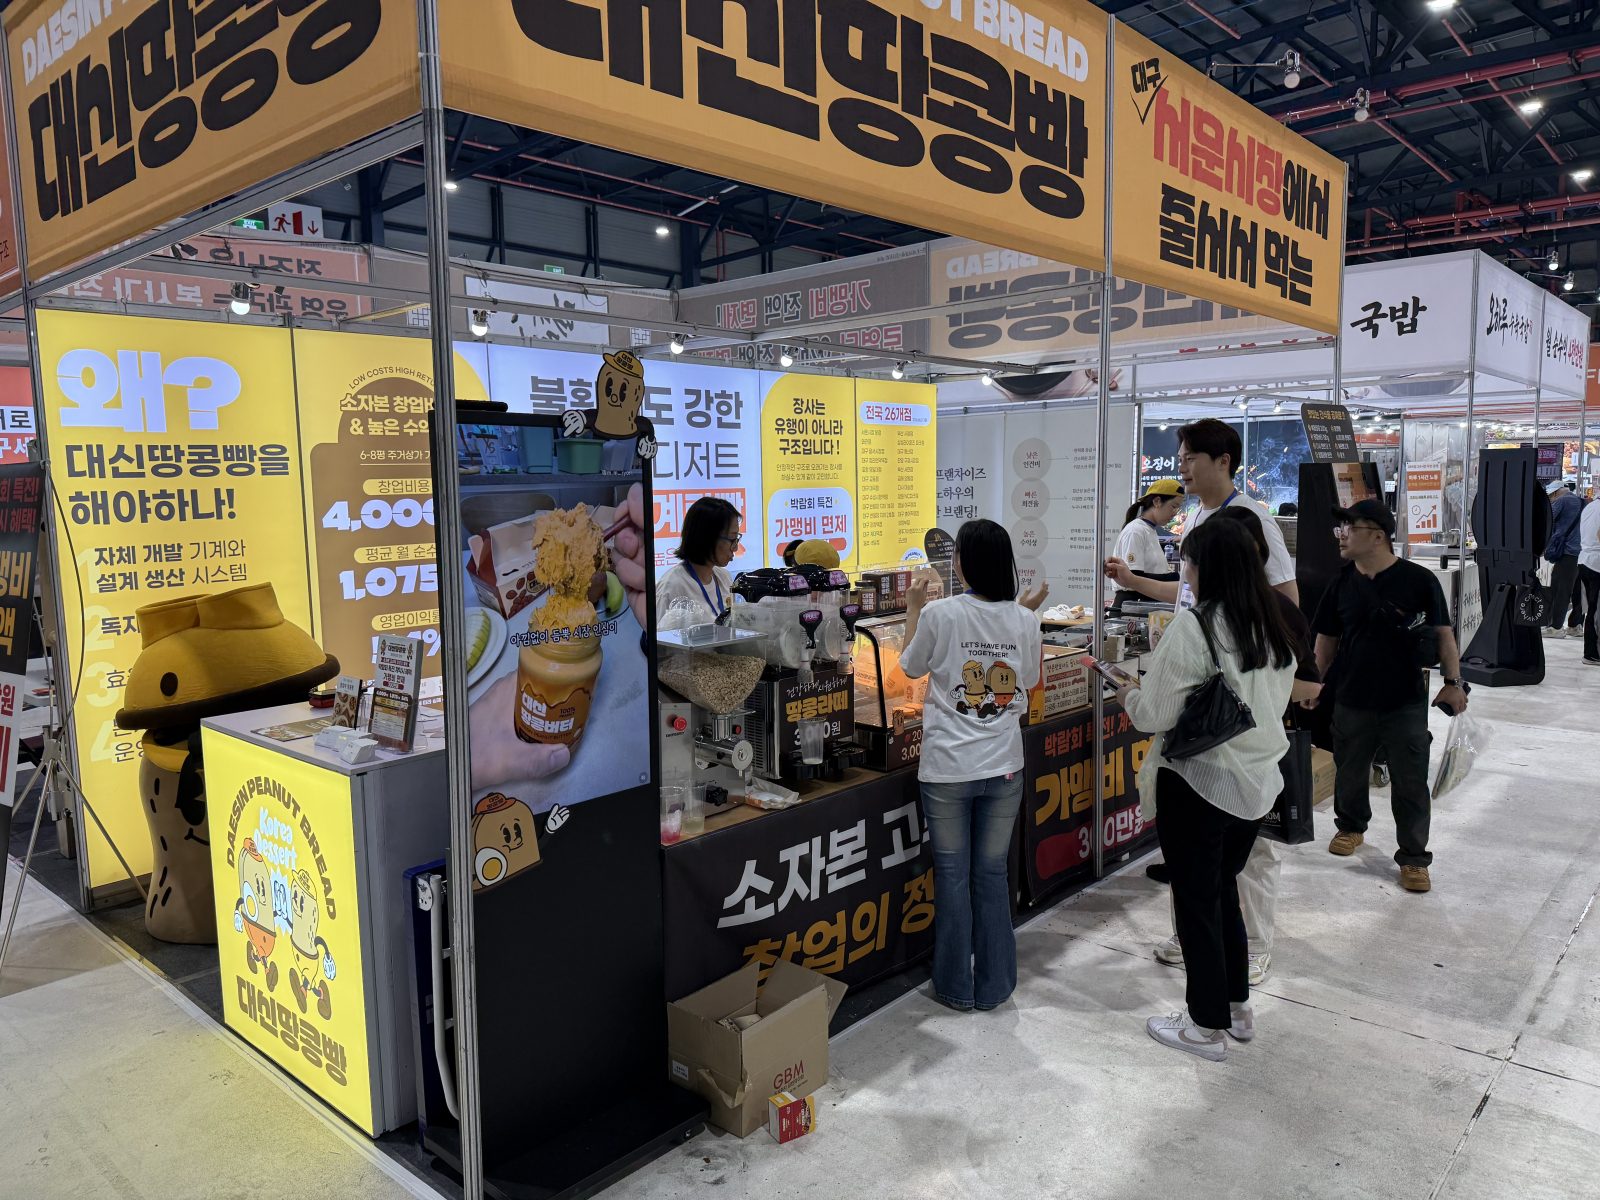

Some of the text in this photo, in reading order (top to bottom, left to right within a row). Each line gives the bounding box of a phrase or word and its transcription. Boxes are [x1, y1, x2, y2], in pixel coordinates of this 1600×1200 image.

[22, 0, 102, 86] DAESIN
[974, 0, 1088, 82] BREAD
[1130, 57, 1162, 94] 대구
[1153, 86, 1330, 240] 서문시장에서
[1159, 183, 1312, 307] 줄서서 먹는
[1350, 296, 1427, 339] 국밥
[57, 348, 241, 432] 왜?
[349, 373, 367, 390] LOW
[366, 366, 394, 378] COSTS
[395, 366, 416, 377] HIGH
[340, 393, 390, 413] 소자본
[684, 388, 744, 430] 강한
[793, 398, 826, 416] 장사는
[866, 405, 912, 421] 전국 26개점
[350, 418, 364, 436] &
[367, 417, 400, 436] 높은
[774, 417, 843, 436] 유행이 아니라
[65, 444, 290, 479] 대신땅콩빵을
[359, 450, 386, 460] 6-8평
[1144, 456, 1175, 471] 오징어
[13, 476, 40, 503] 특전!
[378, 479, 430, 494] 창업비용
[68, 487, 236, 525] 해야하나!
[791, 496, 833, 510] 박람회 특전
[943, 505, 978, 519] 브랜딩!
[10, 507, 37, 534] 혜택!
[775, 514, 847, 538] 가맹비 면제
[95, 539, 246, 567] 자체 개발 기계와
[365, 546, 392, 562] 평균
[396, 545, 410, 560] 월
[96, 564, 247, 593] 설계 생산 시스템
[510, 630, 549, 647] 아낌없이
[573, 623, 591, 638] 시장
[592, 621, 618, 635] 인심이
[961, 641, 1016, 651] LET'S HAVE FUN
[786, 690, 849, 723] 땅콩라떼
[1044, 724, 1083, 757] 박람회
[259, 806, 293, 845] Korea
[227, 775, 337, 921] DAESIN PEANUT BREAD
[253, 828, 297, 871] Dessert
[717, 818, 867, 929] 소자본
[236, 974, 348, 1087] 대신땅콩빵
[773, 1060, 804, 1090] GBM
